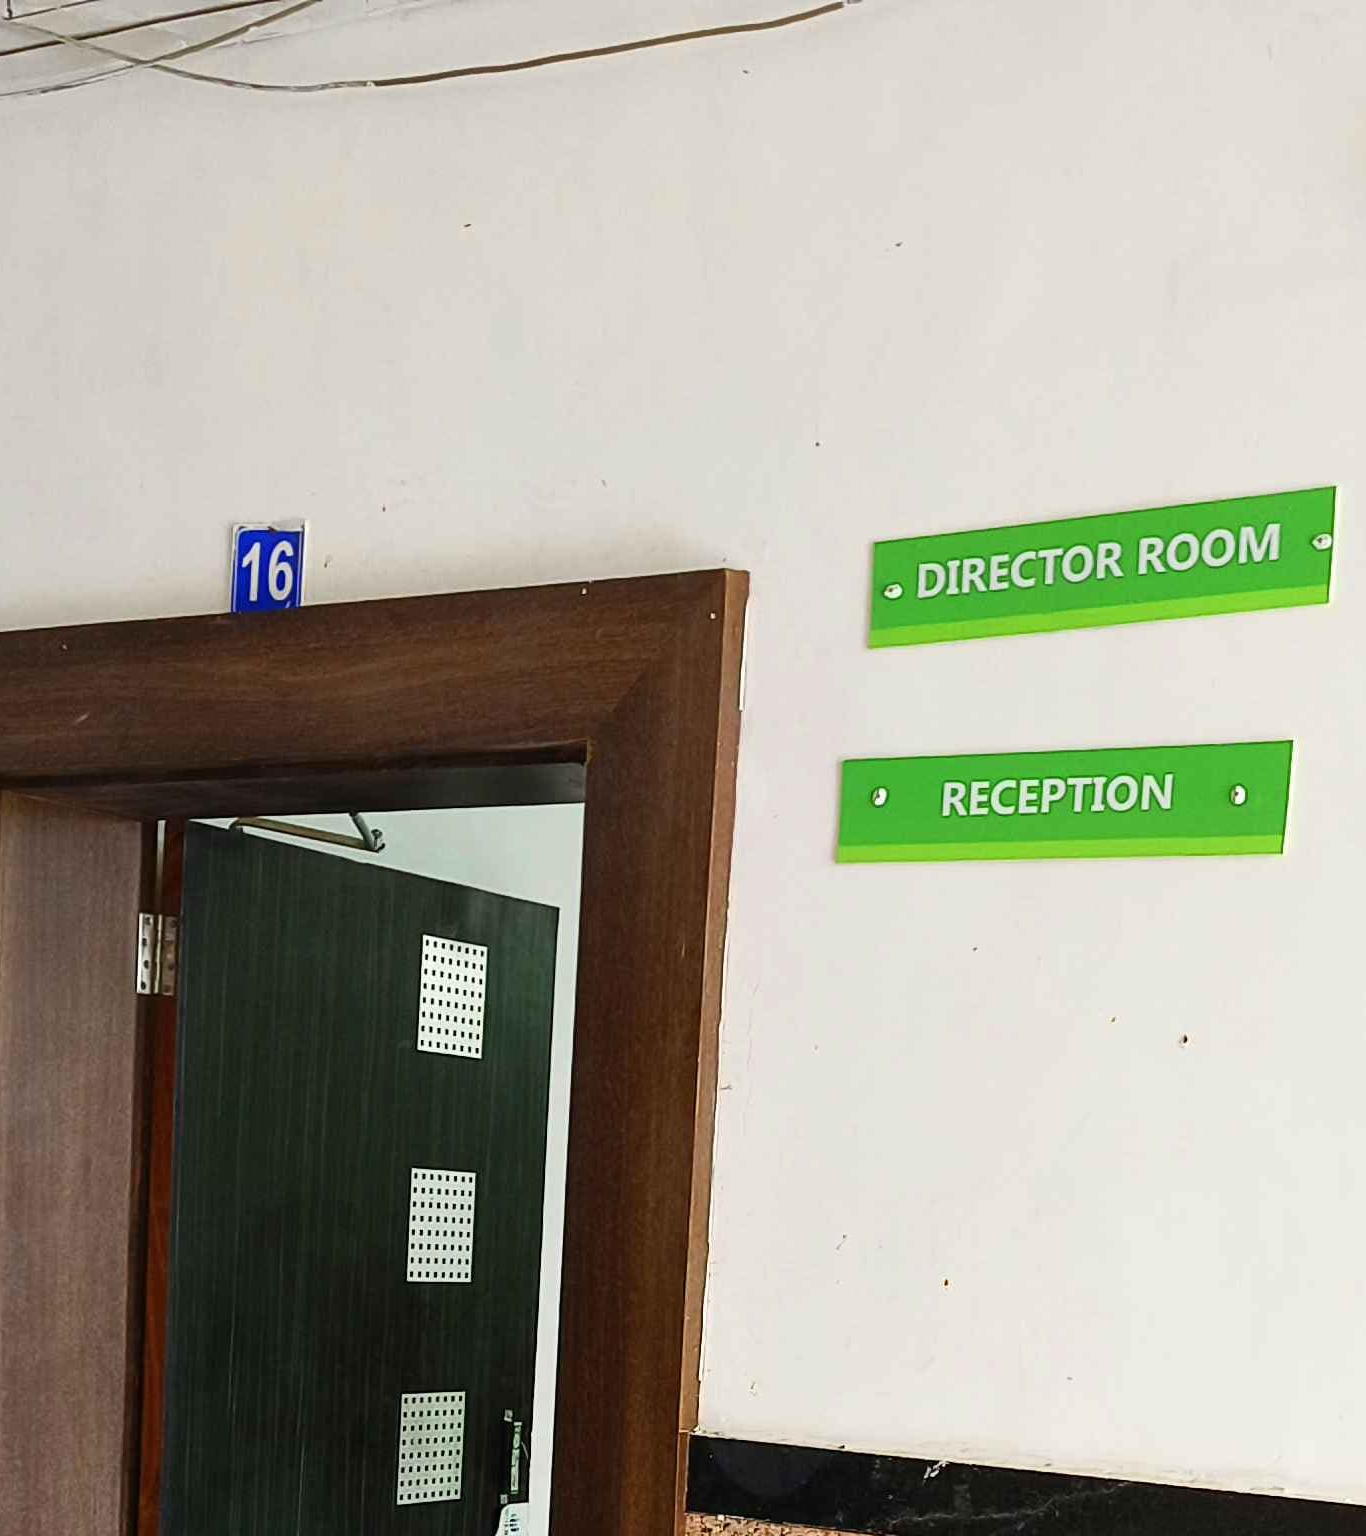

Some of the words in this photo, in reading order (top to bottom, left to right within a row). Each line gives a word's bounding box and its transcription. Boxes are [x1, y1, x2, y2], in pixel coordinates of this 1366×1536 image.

[242, 540, 294, 602] 16
[916, 543, 1124, 598] DIRECTOR
[1137, 523, 1281, 575] ROOM
[941, 774, 1174, 816] RECEPTION
